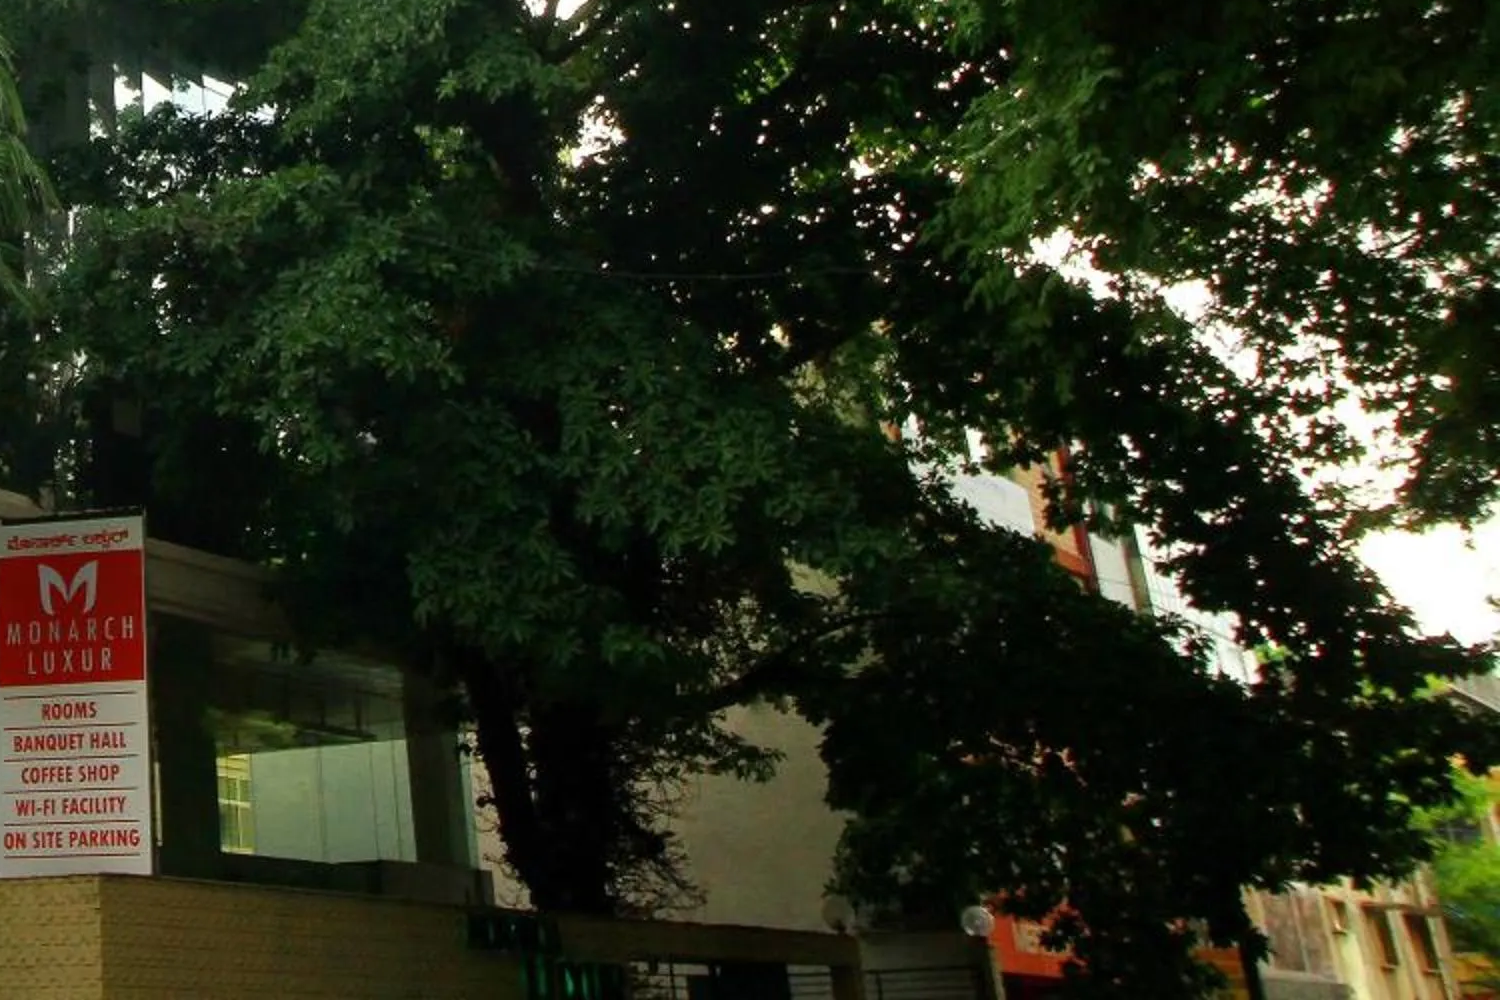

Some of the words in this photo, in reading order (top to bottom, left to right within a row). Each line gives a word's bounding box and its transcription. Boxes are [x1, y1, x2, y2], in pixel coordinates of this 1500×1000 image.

[7, 615, 134, 645] MONARCH
[27, 647, 112, 676] LUXUR
[41, 701, 97, 721] ROOMS
[13, 733, 84, 753] BANQUET
[89, 730, 127, 750] HALL
[21, 766, 74, 785] COFFEE
[79, 764, 120, 783] SHOP
[15, 798, 56, 817] WI-FI
[62, 795, 127, 815] FACILITY
[4, 832, 27, 850] ON
[32, 831, 64, 849] SITE
[70, 829, 140, 848] PARKING
